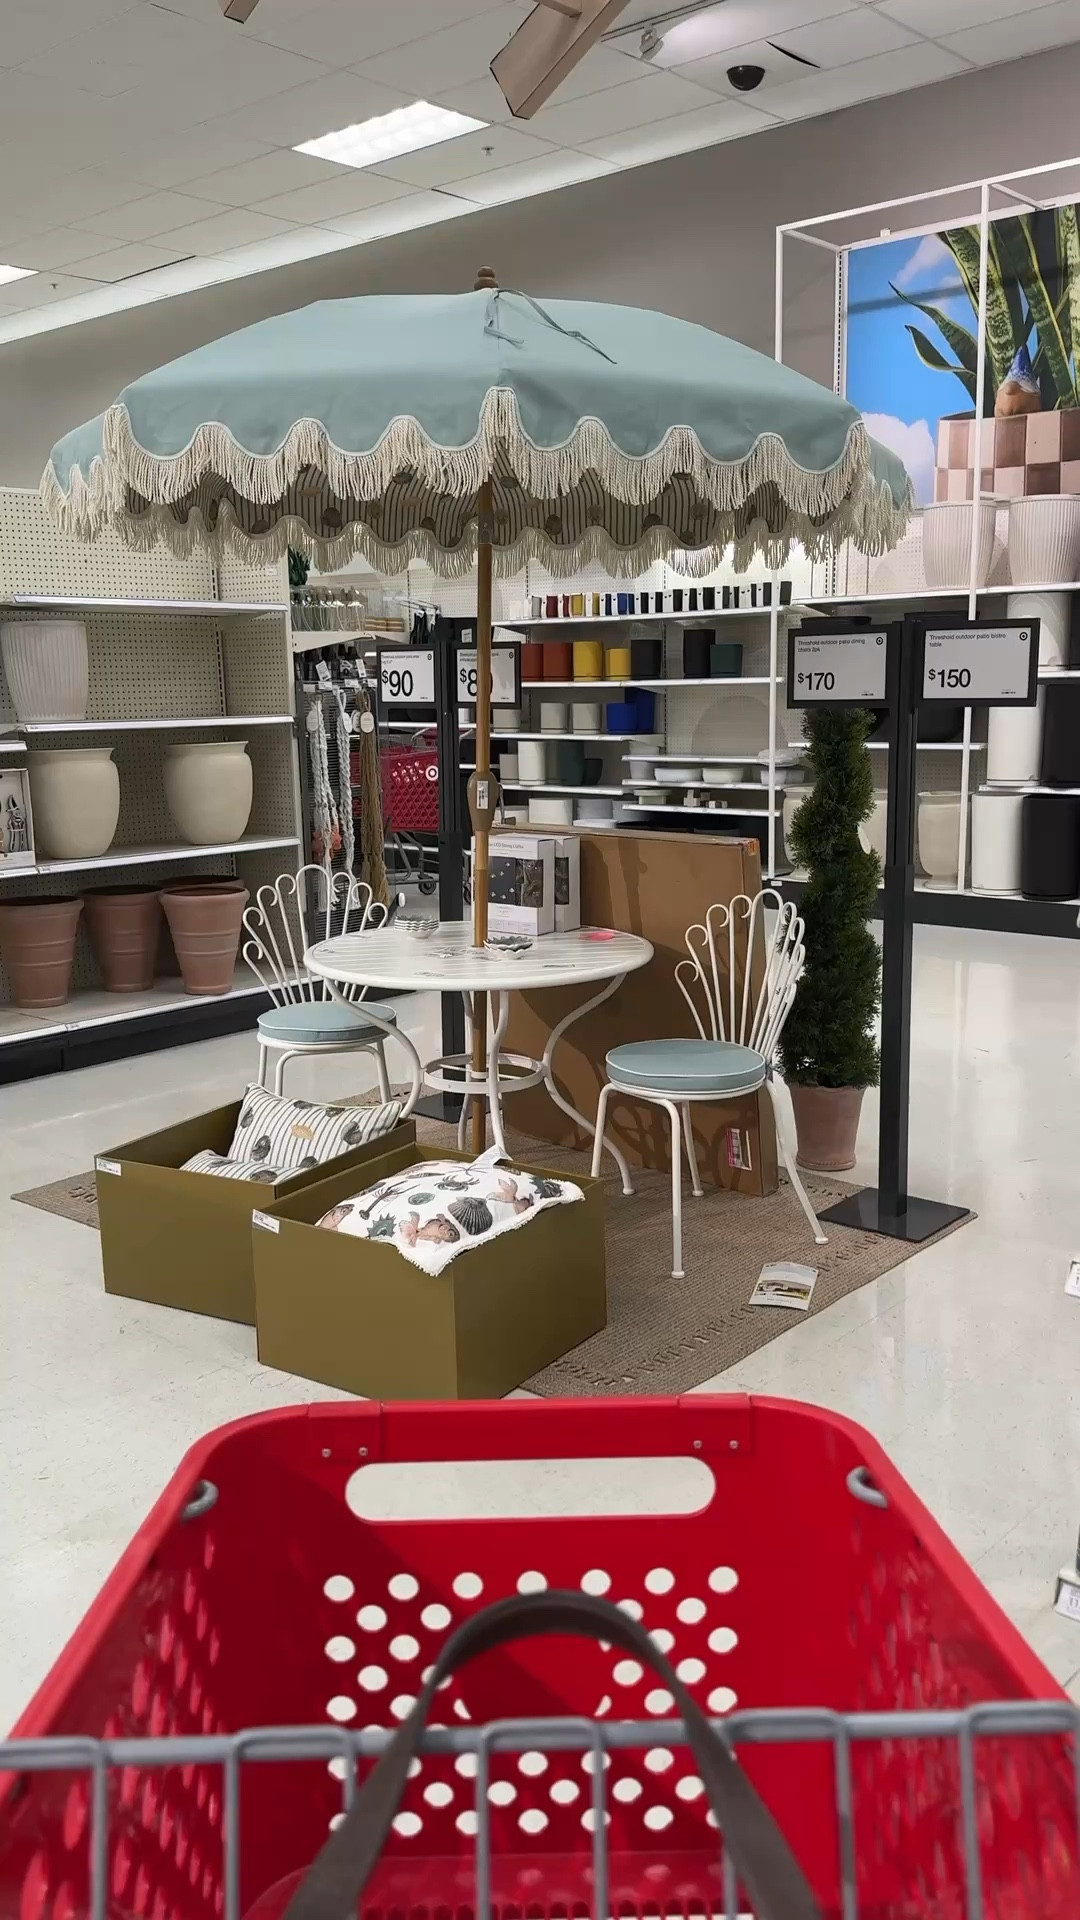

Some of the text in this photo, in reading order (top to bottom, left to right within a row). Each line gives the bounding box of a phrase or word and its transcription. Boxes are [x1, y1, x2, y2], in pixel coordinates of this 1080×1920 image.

[381, 669, 413, 697] $90
[459, 668, 493, 697] $8
[797, 672, 835, 691] $170
[928, 668, 971, 688] $150
